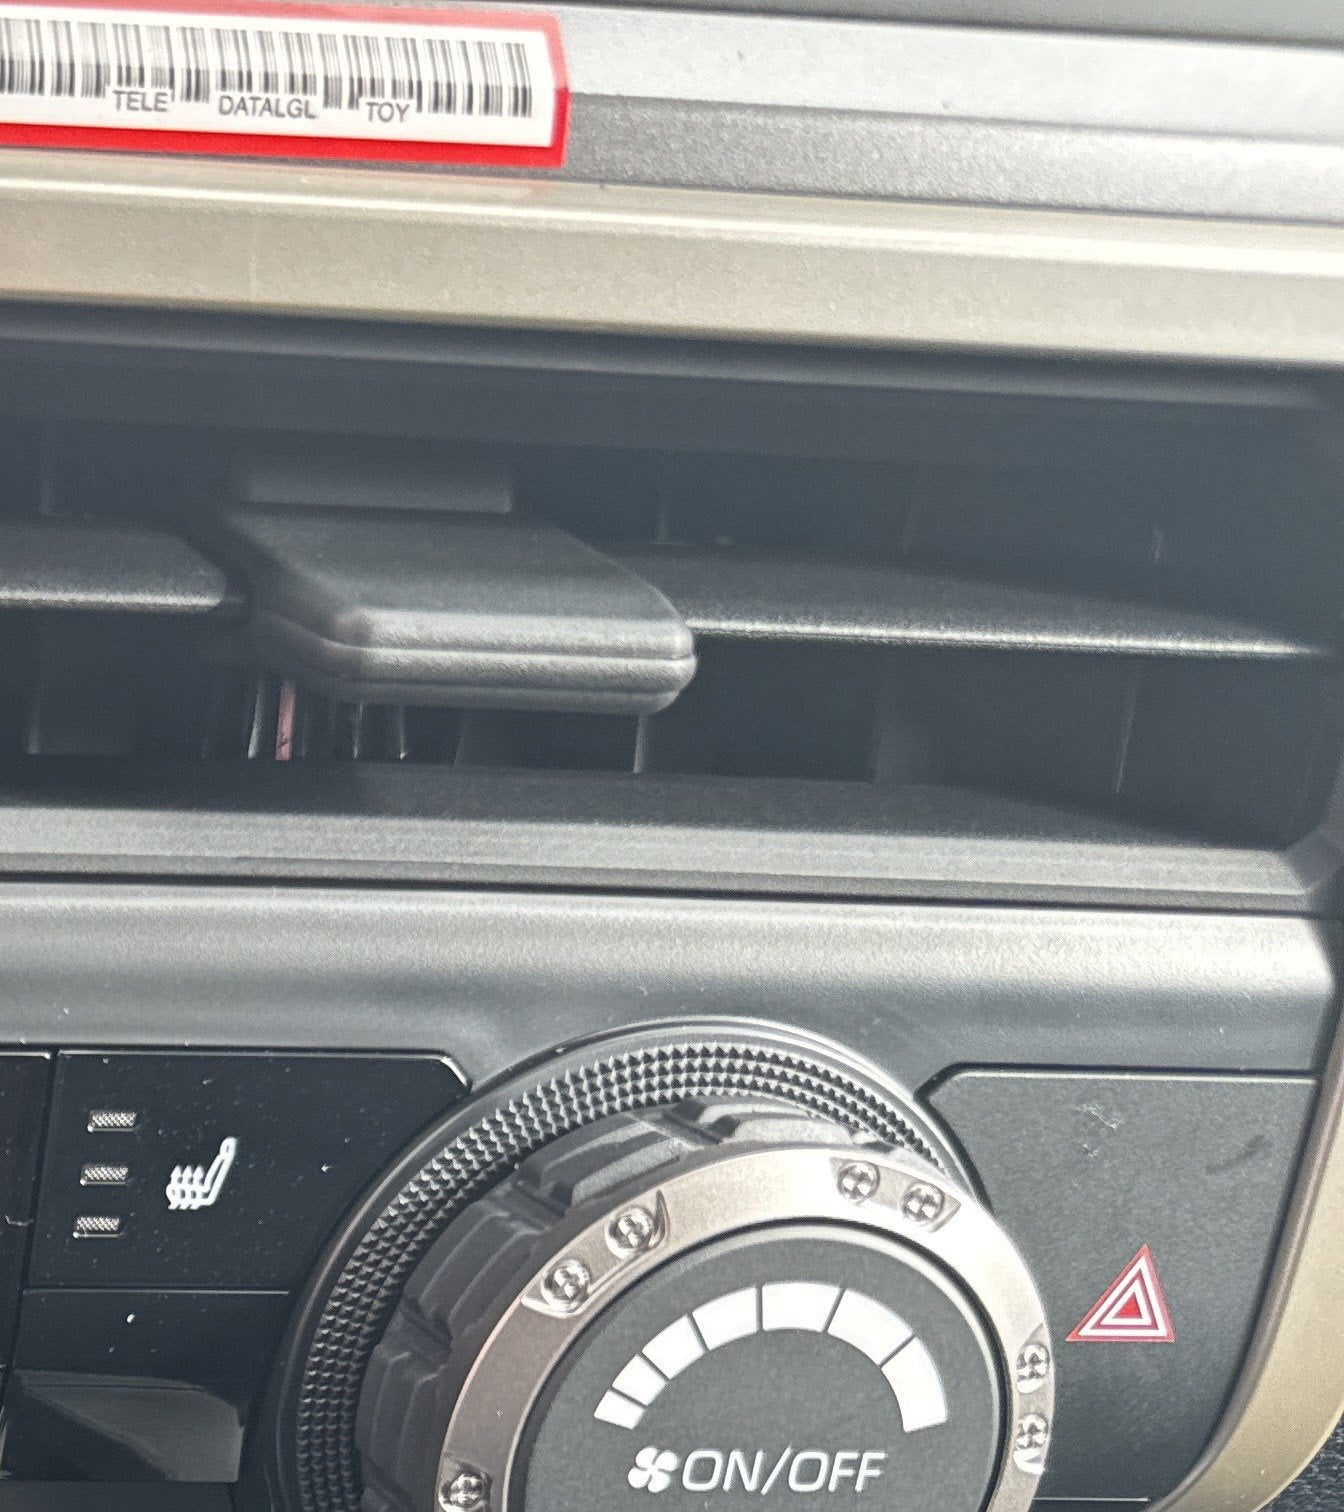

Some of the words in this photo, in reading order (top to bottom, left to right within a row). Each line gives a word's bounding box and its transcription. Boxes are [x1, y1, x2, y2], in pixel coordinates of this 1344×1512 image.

[112, 90, 170, 114] TELE
[218, 94, 318, 122] DATALGL
[364, 100, 411, 124] TOY
[681, 1444, 888, 1495] ON/OFF
